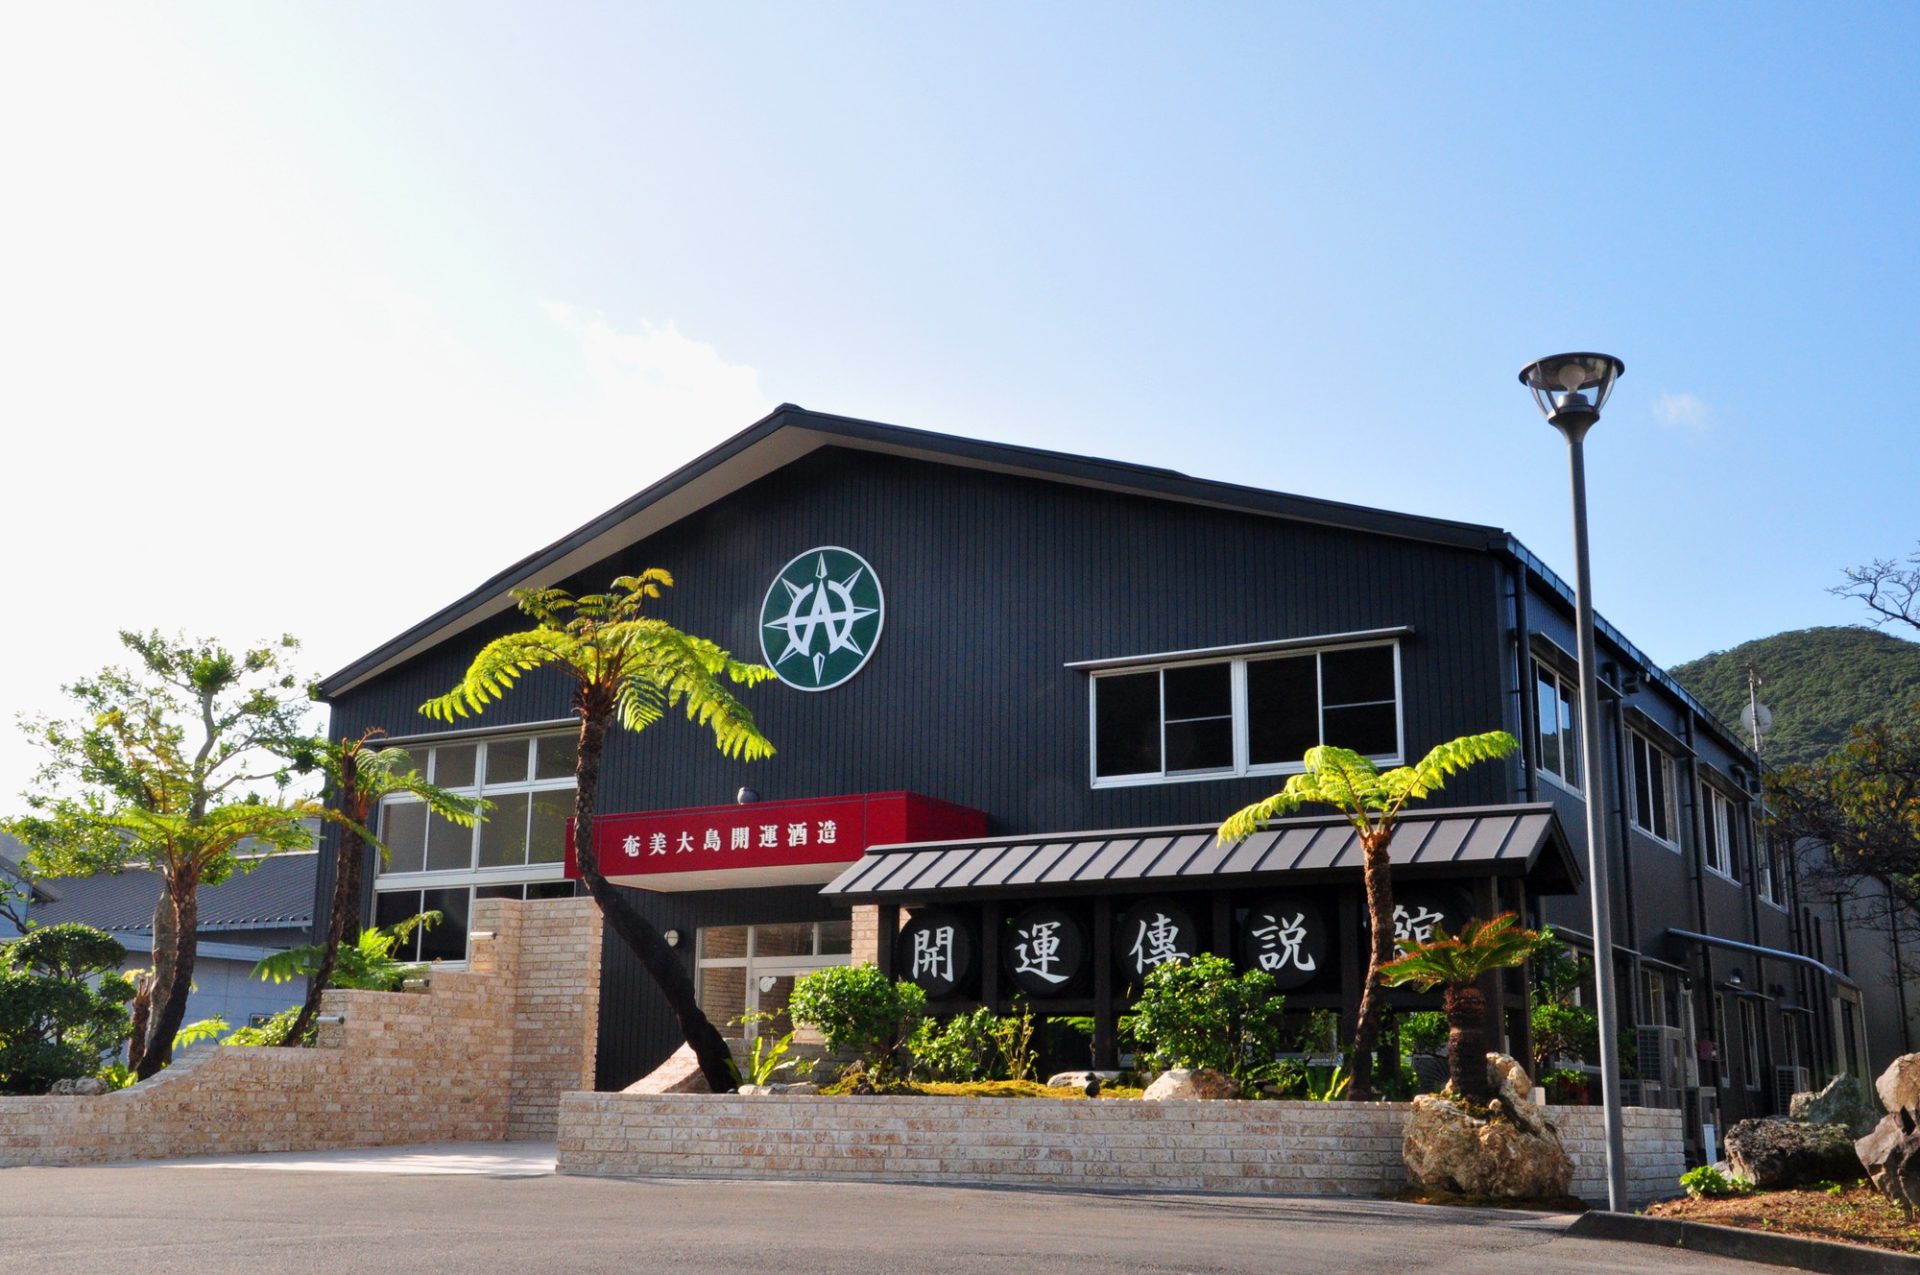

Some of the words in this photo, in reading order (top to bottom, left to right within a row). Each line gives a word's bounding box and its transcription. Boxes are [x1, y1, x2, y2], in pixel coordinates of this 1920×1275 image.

[622, 820, 837, 857] 奄美大島開運酒造
